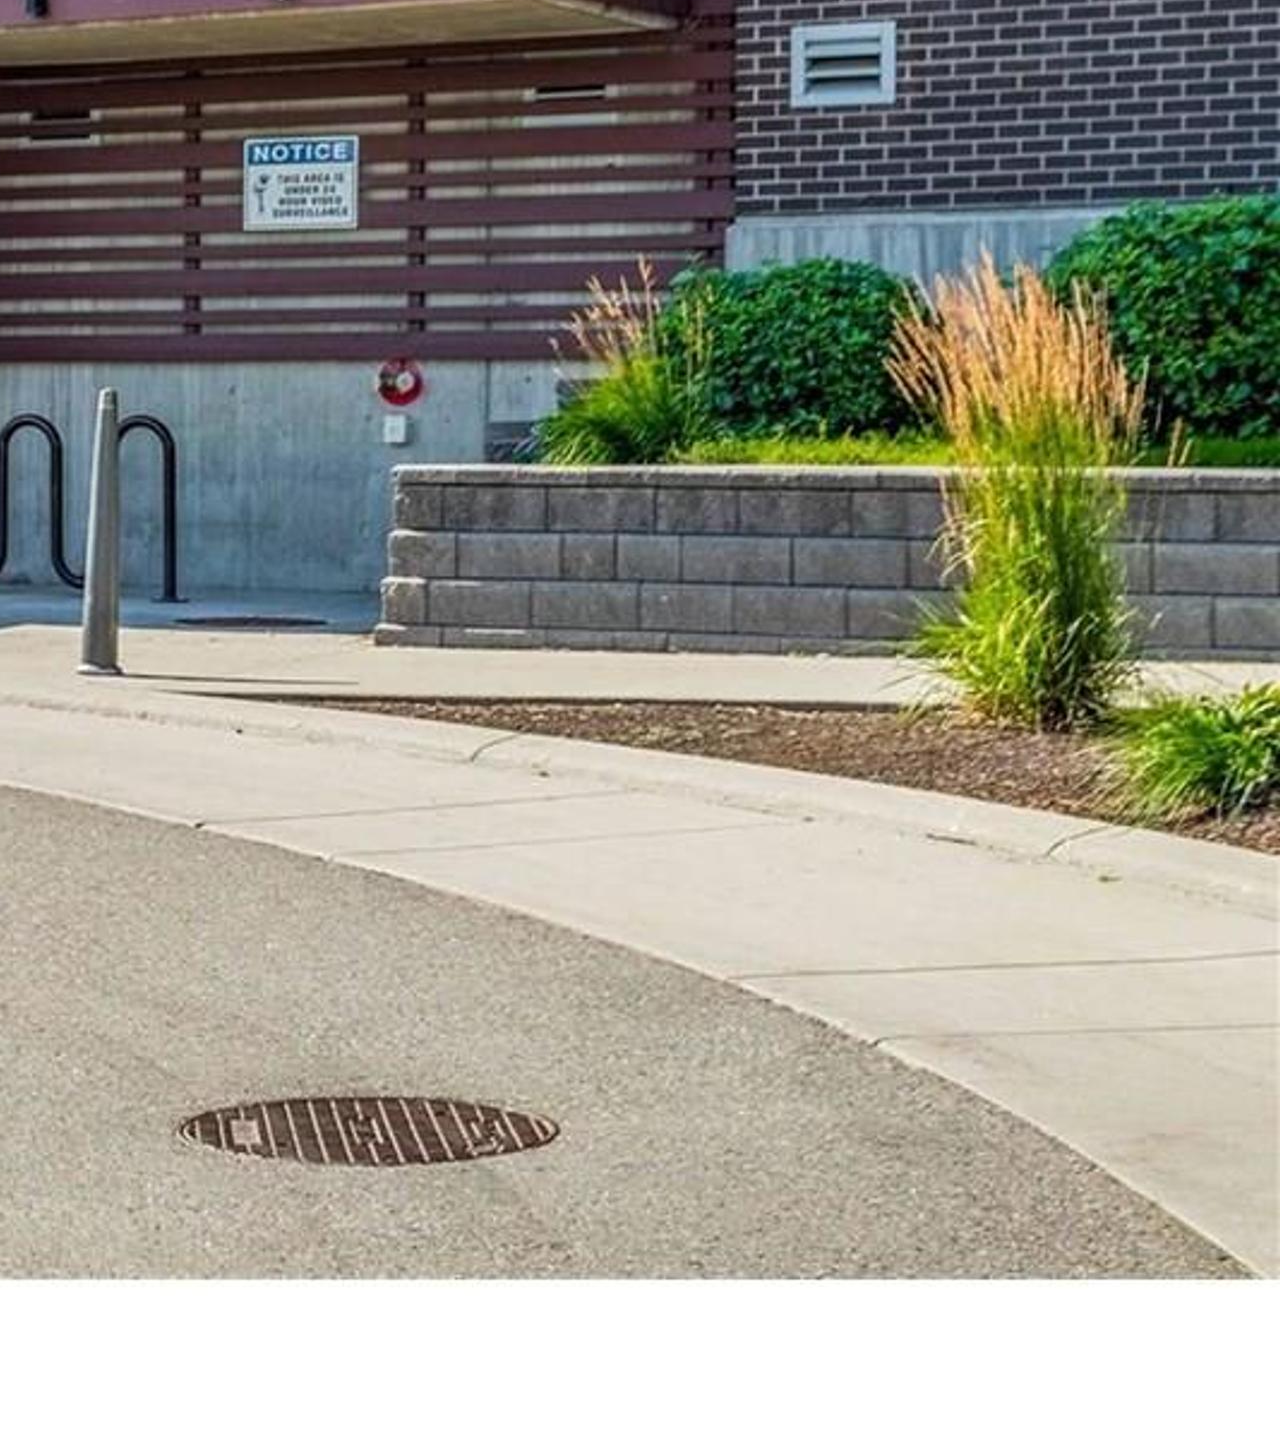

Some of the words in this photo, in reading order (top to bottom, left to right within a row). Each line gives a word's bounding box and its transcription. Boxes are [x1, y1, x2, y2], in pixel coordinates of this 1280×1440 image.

[252, 142, 349, 162] NOTICE
[303, 173, 331, 183] AREA
[284, 185, 319, 195] UNDER
[278, 197, 307, 206] HOUR
[311, 196, 342, 205] VIDEO
[272, 206, 348, 218] SURVEILLANCE
